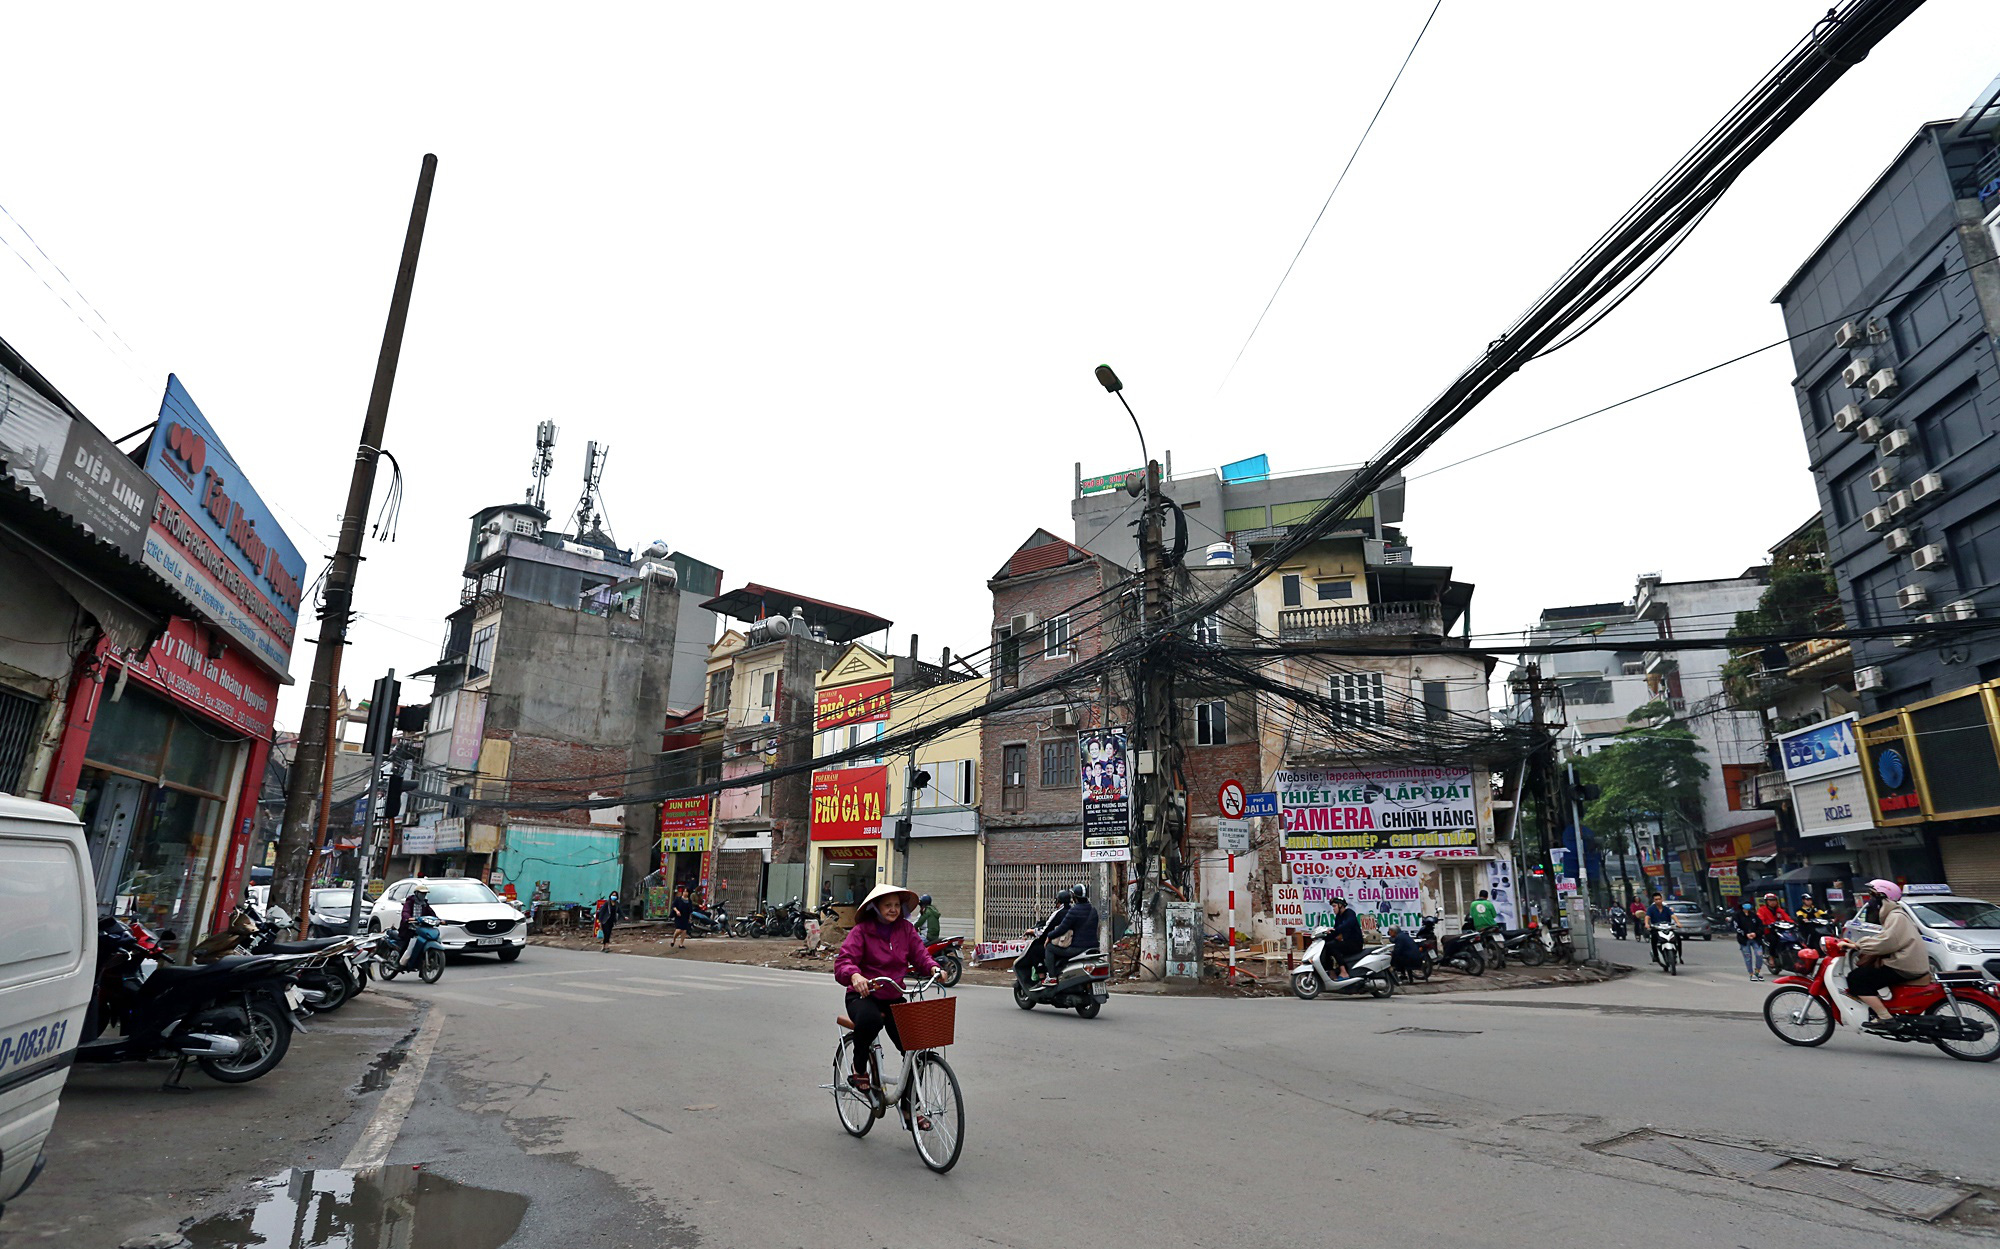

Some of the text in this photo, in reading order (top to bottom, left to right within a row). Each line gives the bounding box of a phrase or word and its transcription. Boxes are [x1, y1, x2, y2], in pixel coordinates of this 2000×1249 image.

[74, 446, 111, 485] DIỆP
[112, 477, 145, 516] LINH
[161, 504, 192, 547] THỐNG
[200, 466, 231, 529] Tân
[226, 501, 267, 576] Hoàng
[161, 630, 175, 657] Ty
[176, 638, 203, 672] TNHH
[202, 656, 218, 683] Tân
[219, 672, 243, 701] Hoàng
[847, 692, 866, 718] GÀ
[1277, 767, 1469, 783] Website: lapcamerachinhhang.com
[1338, 784, 1364, 803] KẾ
[1385, 783, 1424, 801] LẮP
[1431, 783, 1471, 803] ĐẶT
[814, 783, 881, 824] PHỞ GÀ TA
[1262, 803, 1274, 812] LA
[1823, 804, 1853, 821] KORE
[1283, 806, 1475, 831] CAMERA CHÍNH HÃNG
[1331, 832, 1379, 850] NGHIỆP
[1391, 834, 1412, 848] CHI
[1417, 830, 1439, 846] PHÍ
[1442, 828, 1476, 846] THẤP
[1293, 862, 1418, 879] CHO: CỬA HÀNG
[1278, 884, 1299, 900] SỬA
[1358, 888, 1381, 900] GIA
[1385, 885, 1420, 900] ĐÌNH
[1275, 903, 1303, 915] KHÓA
[1403, 912, 1423, 928] TY
